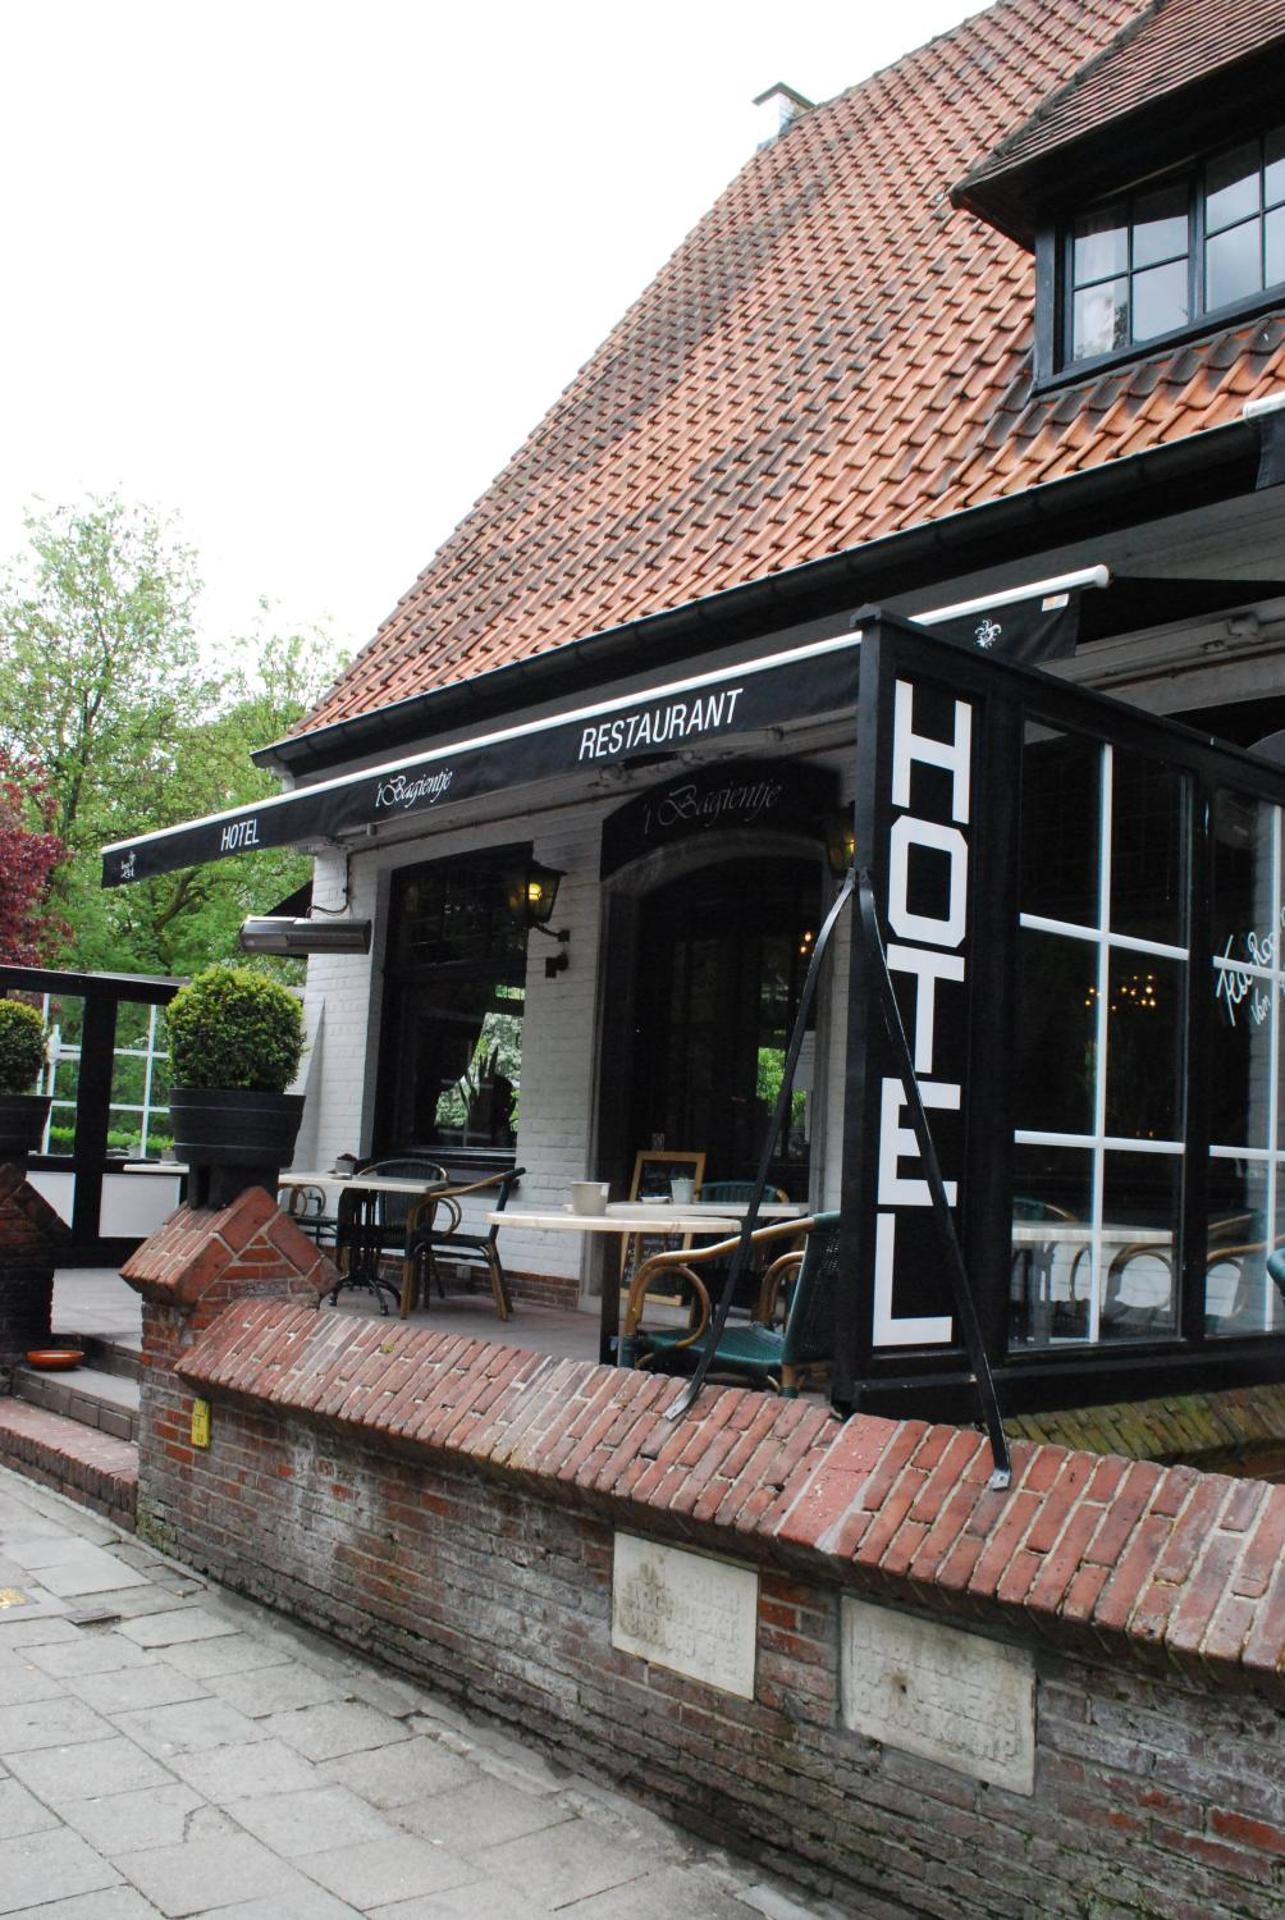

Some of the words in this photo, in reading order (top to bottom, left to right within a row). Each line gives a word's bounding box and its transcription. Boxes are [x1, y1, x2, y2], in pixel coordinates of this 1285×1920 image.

[578, 688, 744, 760] RESTAURANT
[220, 819, 259, 851] HOTEL
[872, 679, 972, 1346] HOTEL
